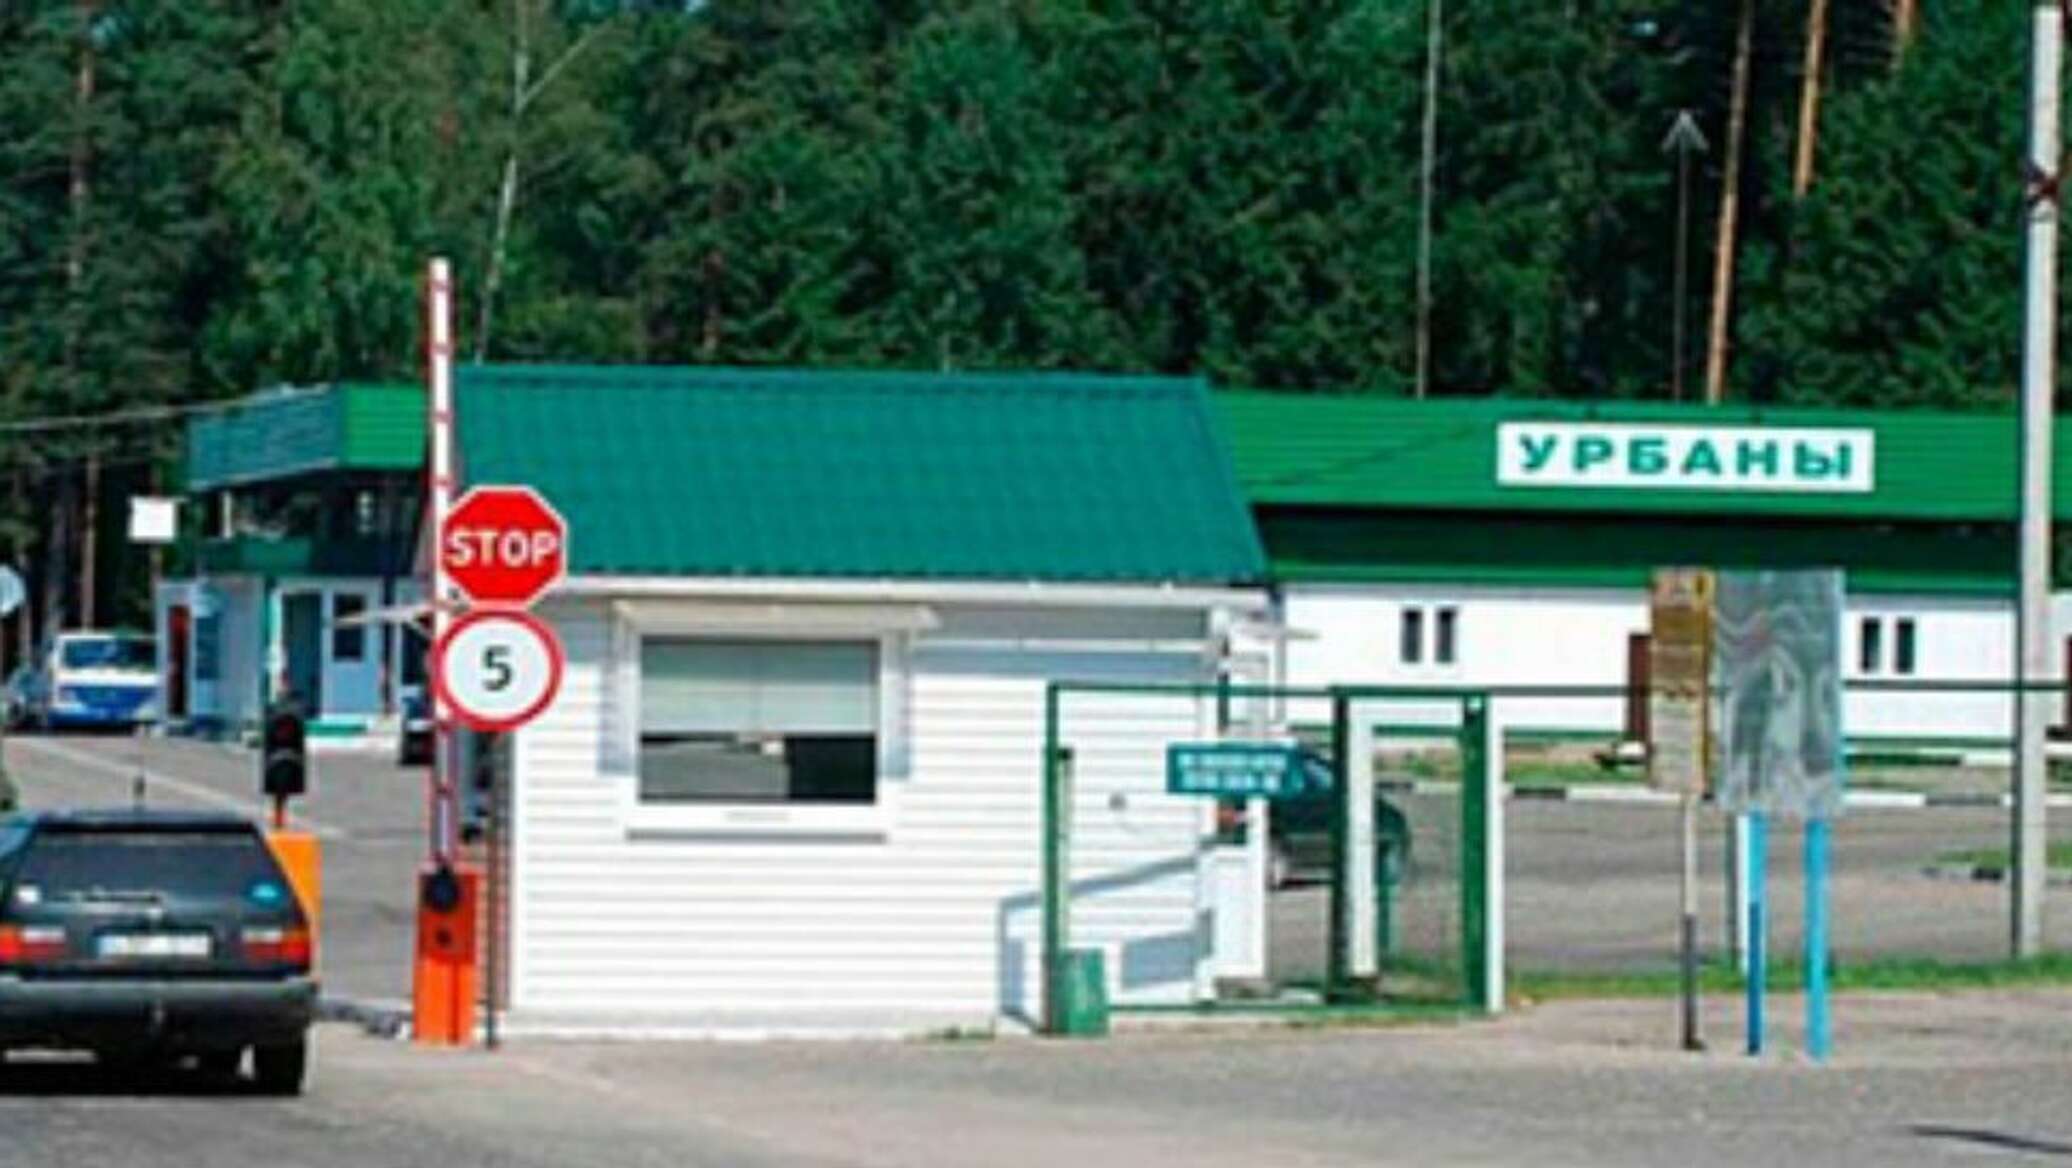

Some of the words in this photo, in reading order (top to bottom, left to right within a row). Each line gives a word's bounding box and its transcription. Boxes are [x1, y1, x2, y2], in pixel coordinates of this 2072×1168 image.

[1518, 433, 1853, 480] УРБАНЫ
[444, 528, 559, 568] STOP
[482, 644, 513, 693] 5
